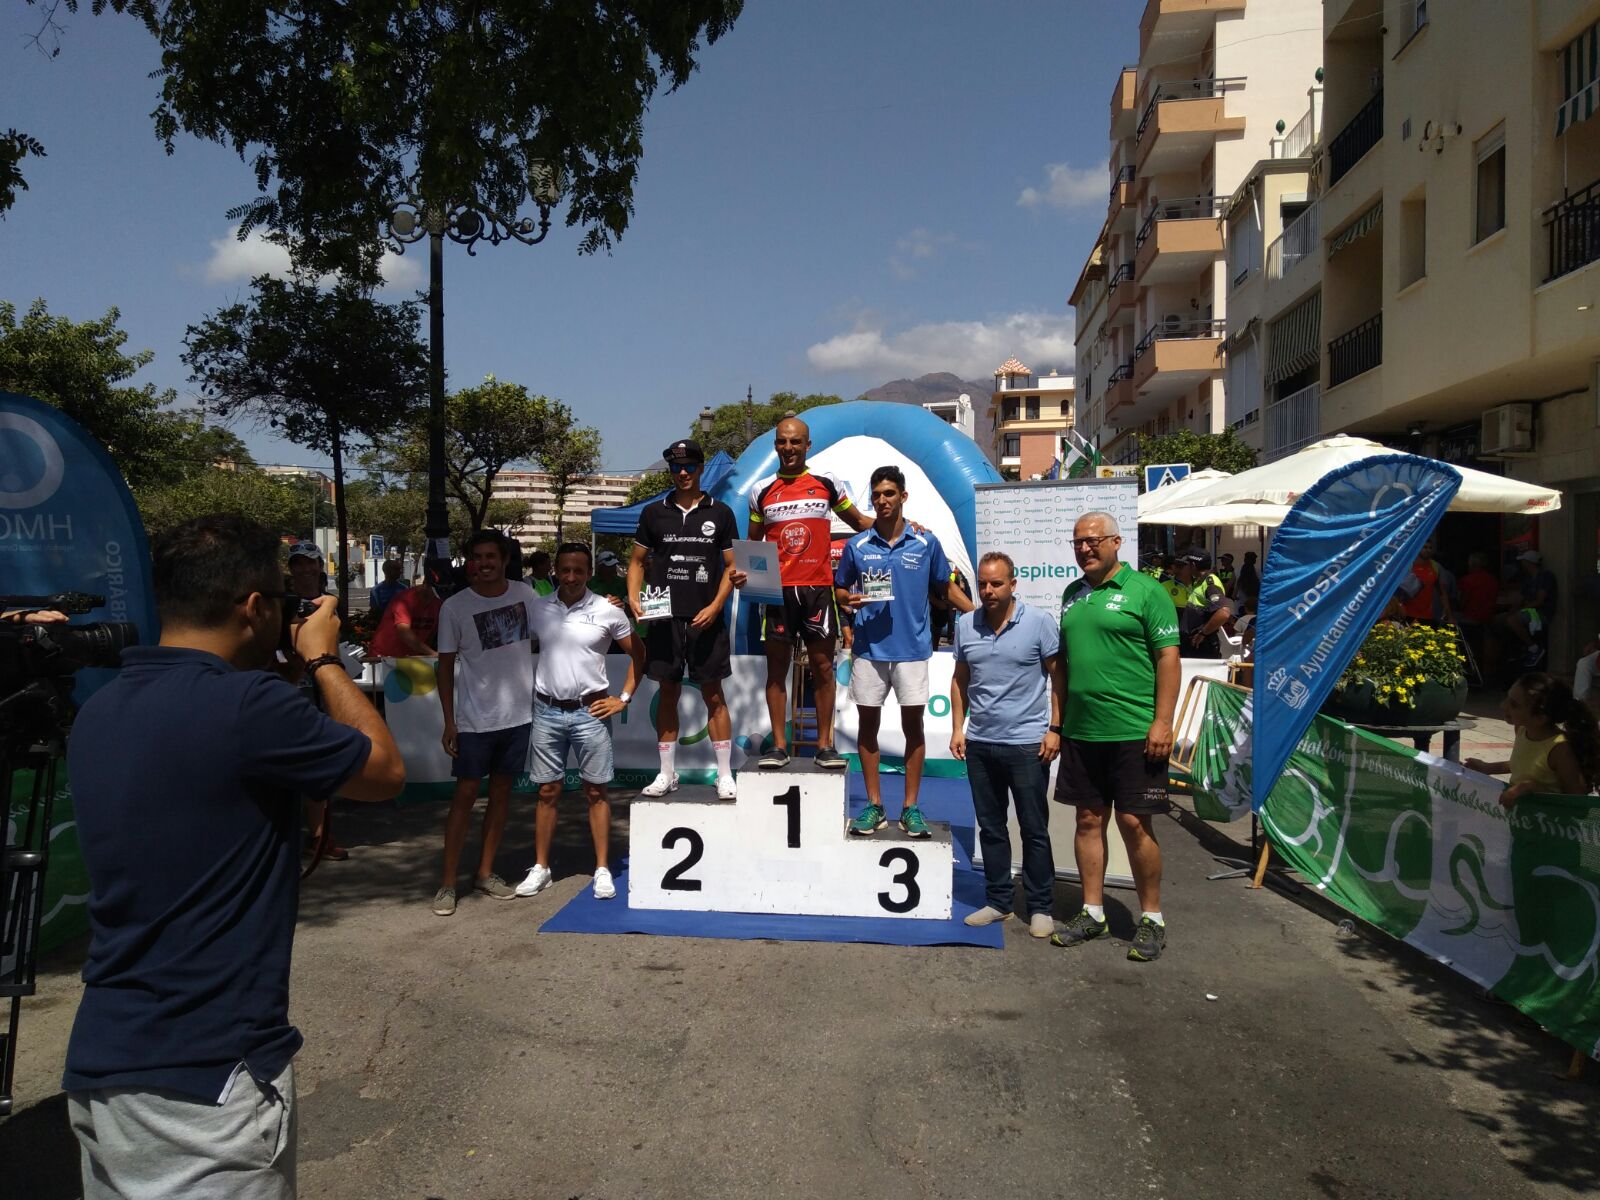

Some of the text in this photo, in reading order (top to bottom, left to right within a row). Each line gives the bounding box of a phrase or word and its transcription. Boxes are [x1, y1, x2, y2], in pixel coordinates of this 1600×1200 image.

[1013, 562, 1078, 582] ospiten
[1300, 576, 1376, 680] Ayuntamiento
[1375, 552, 1394, 574] de
[773, 785, 801, 849] 1
[661, 826, 704, 891] 2
[877, 847, 921, 914] 3
